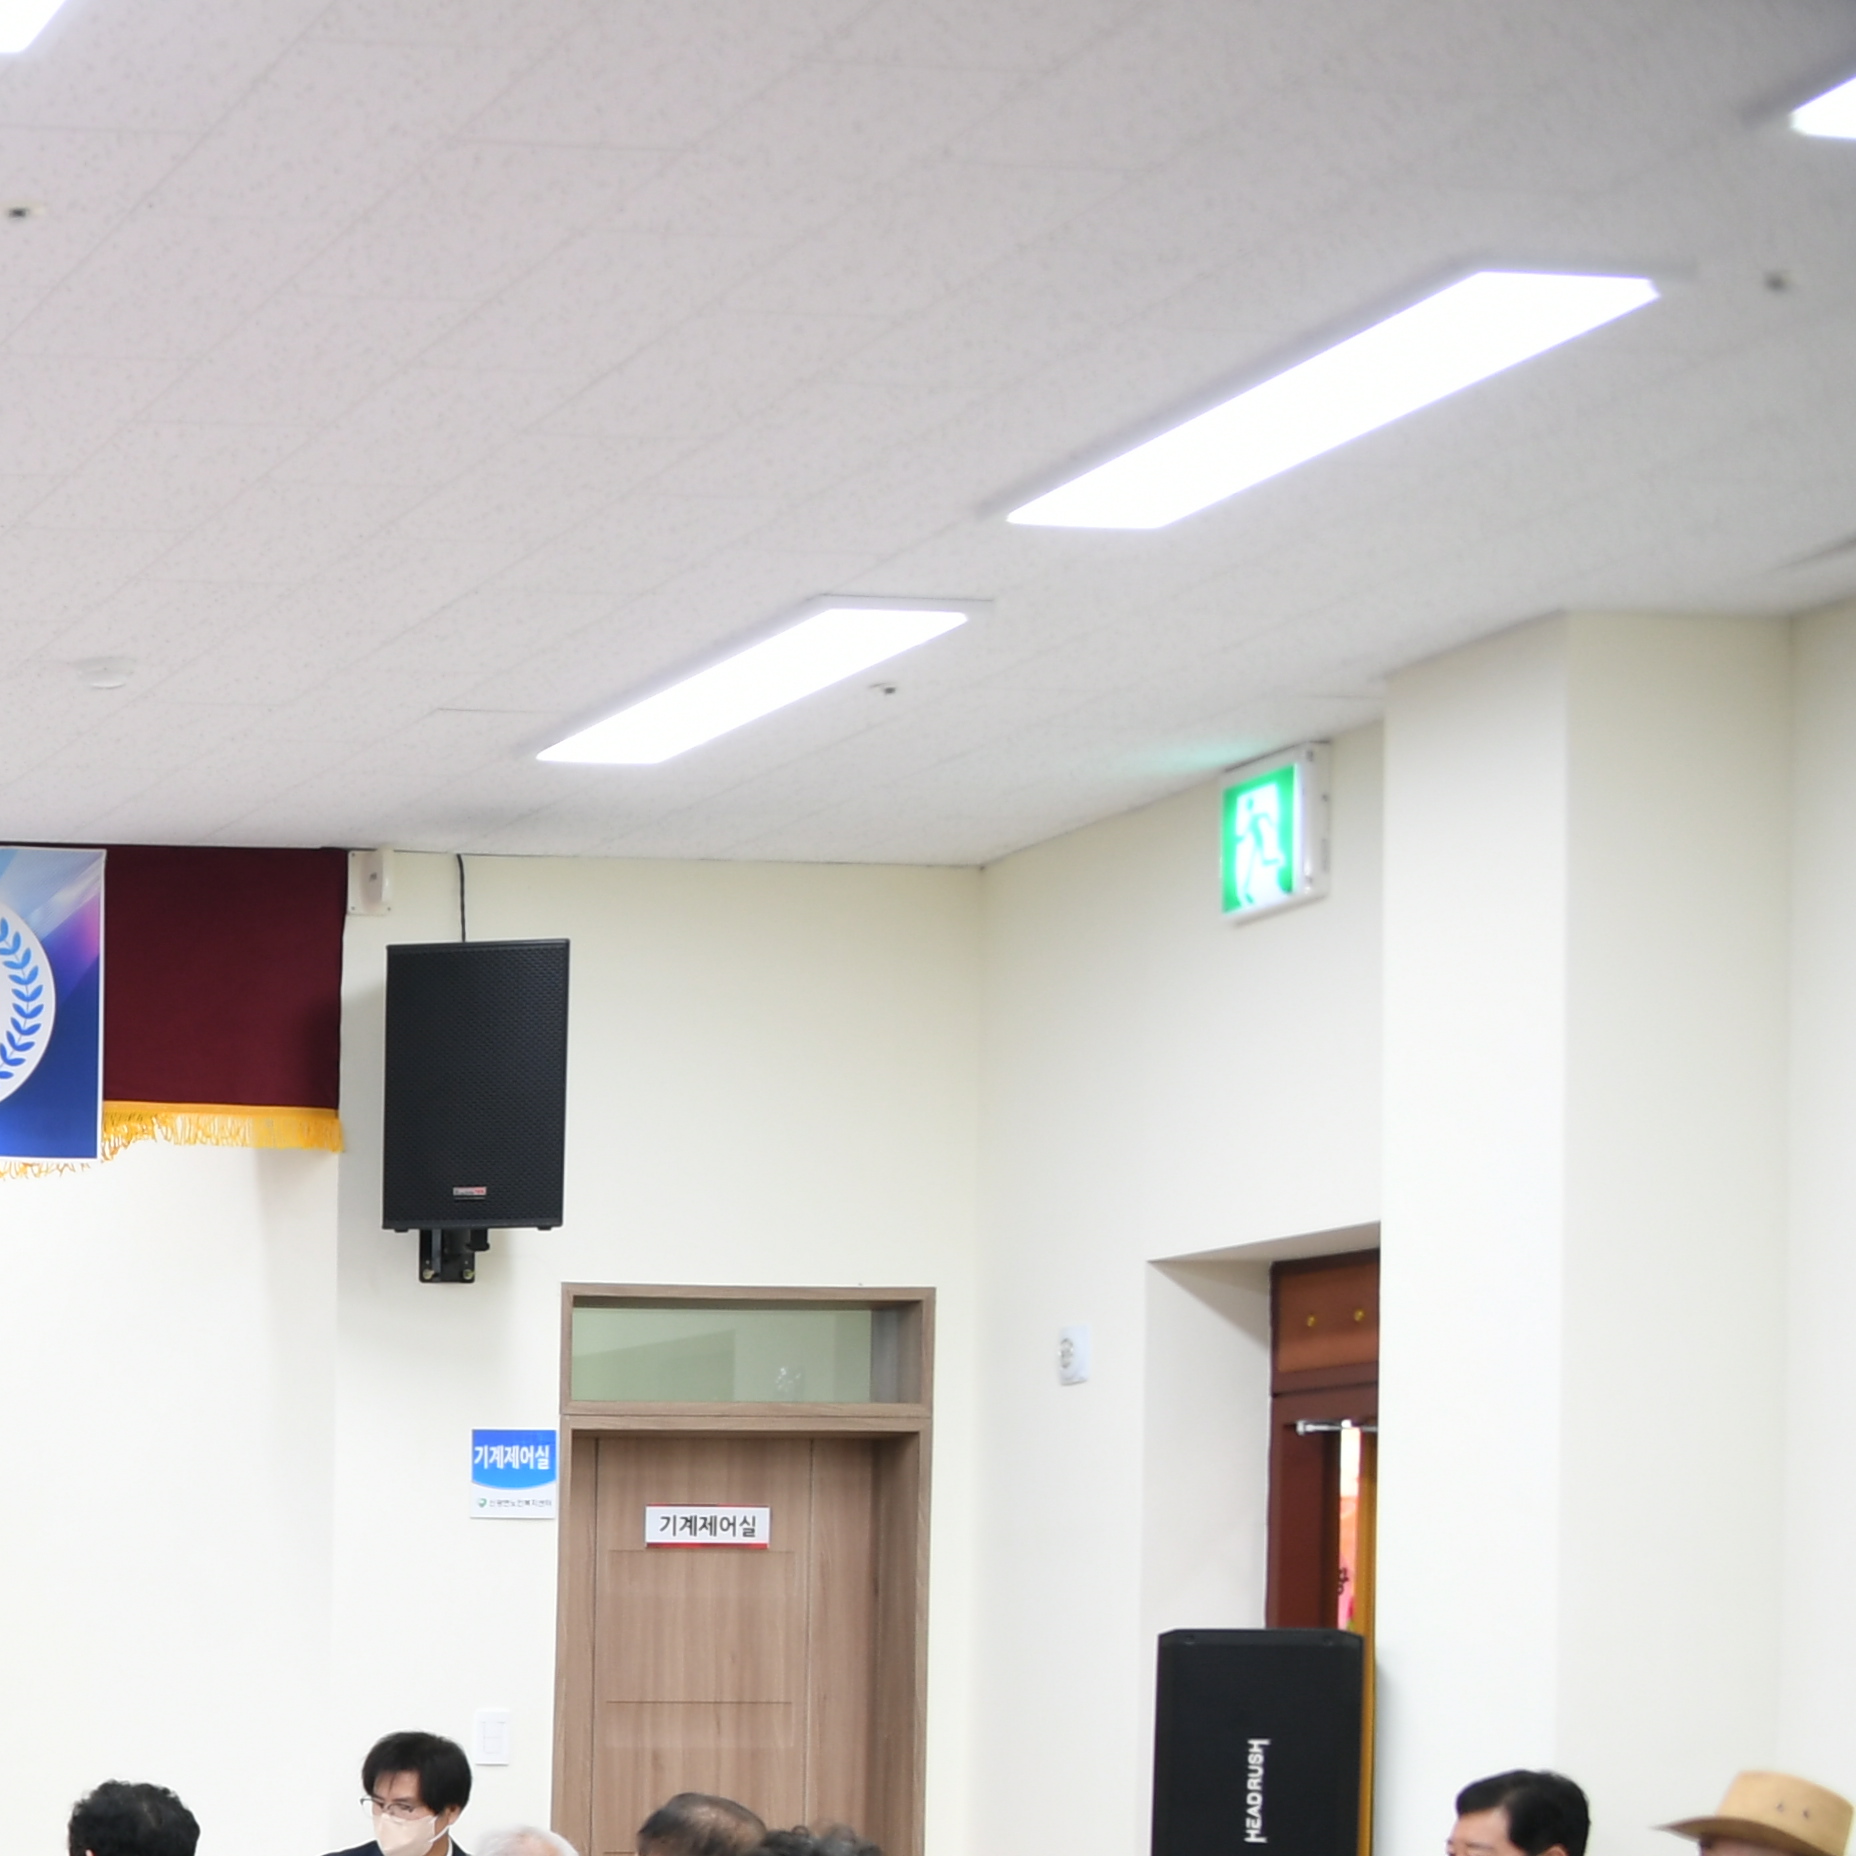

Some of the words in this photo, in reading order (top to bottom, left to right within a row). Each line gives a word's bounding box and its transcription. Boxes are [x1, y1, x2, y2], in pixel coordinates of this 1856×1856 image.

[474, 1445, 550, 1470] 기계제어실
[659, 1514, 757, 1538] 기계제어실
[1244, 1738, 1270, 1843] HEADRUSH
